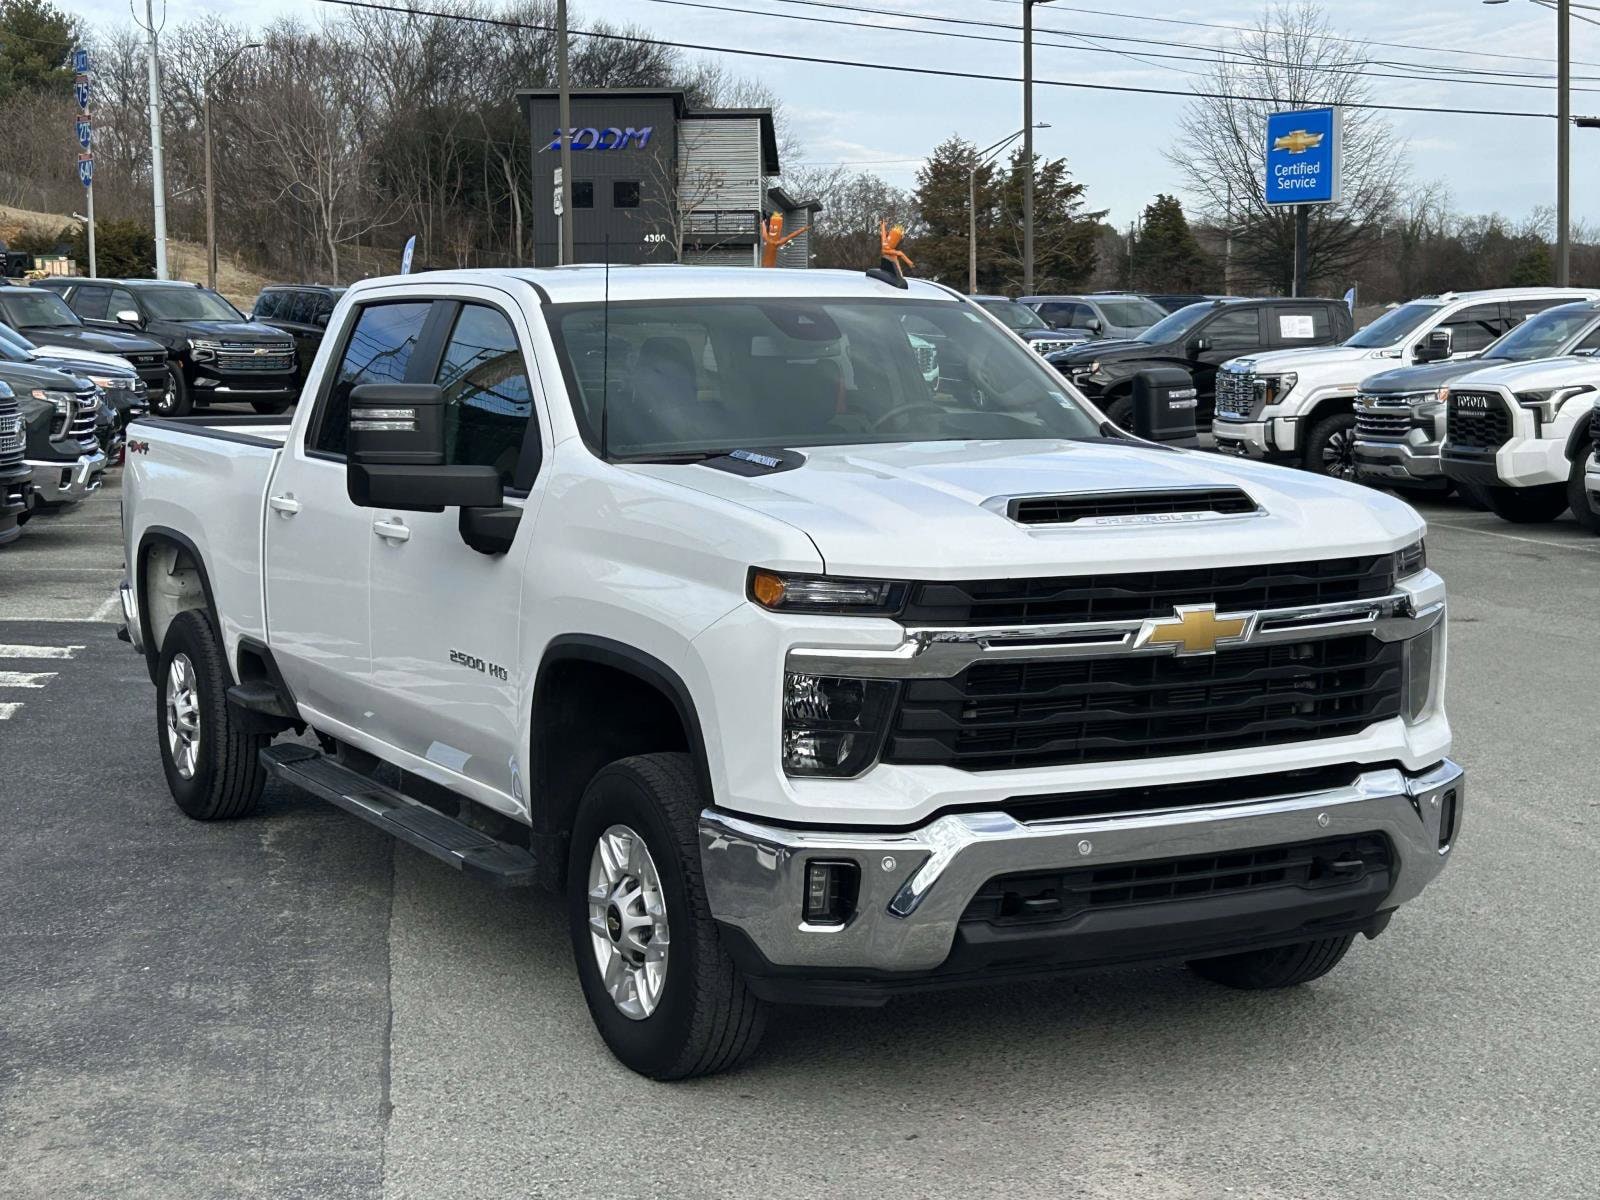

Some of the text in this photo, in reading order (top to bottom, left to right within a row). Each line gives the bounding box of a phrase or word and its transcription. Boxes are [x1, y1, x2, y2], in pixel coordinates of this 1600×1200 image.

[77, 83, 88, 102] 75
[79, 122, 91, 142] 275
[80, 160, 92, 181] 640
[1274, 161, 1320, 176] Certified
[1277, 176, 1316, 189] Service
[643, 234, 666, 243] 4300
[1457, 395, 1488, 408] TOYOTA
[1095, 512, 1202, 525] CHEVROLET
[450, 649, 508, 681] 2500 HD
